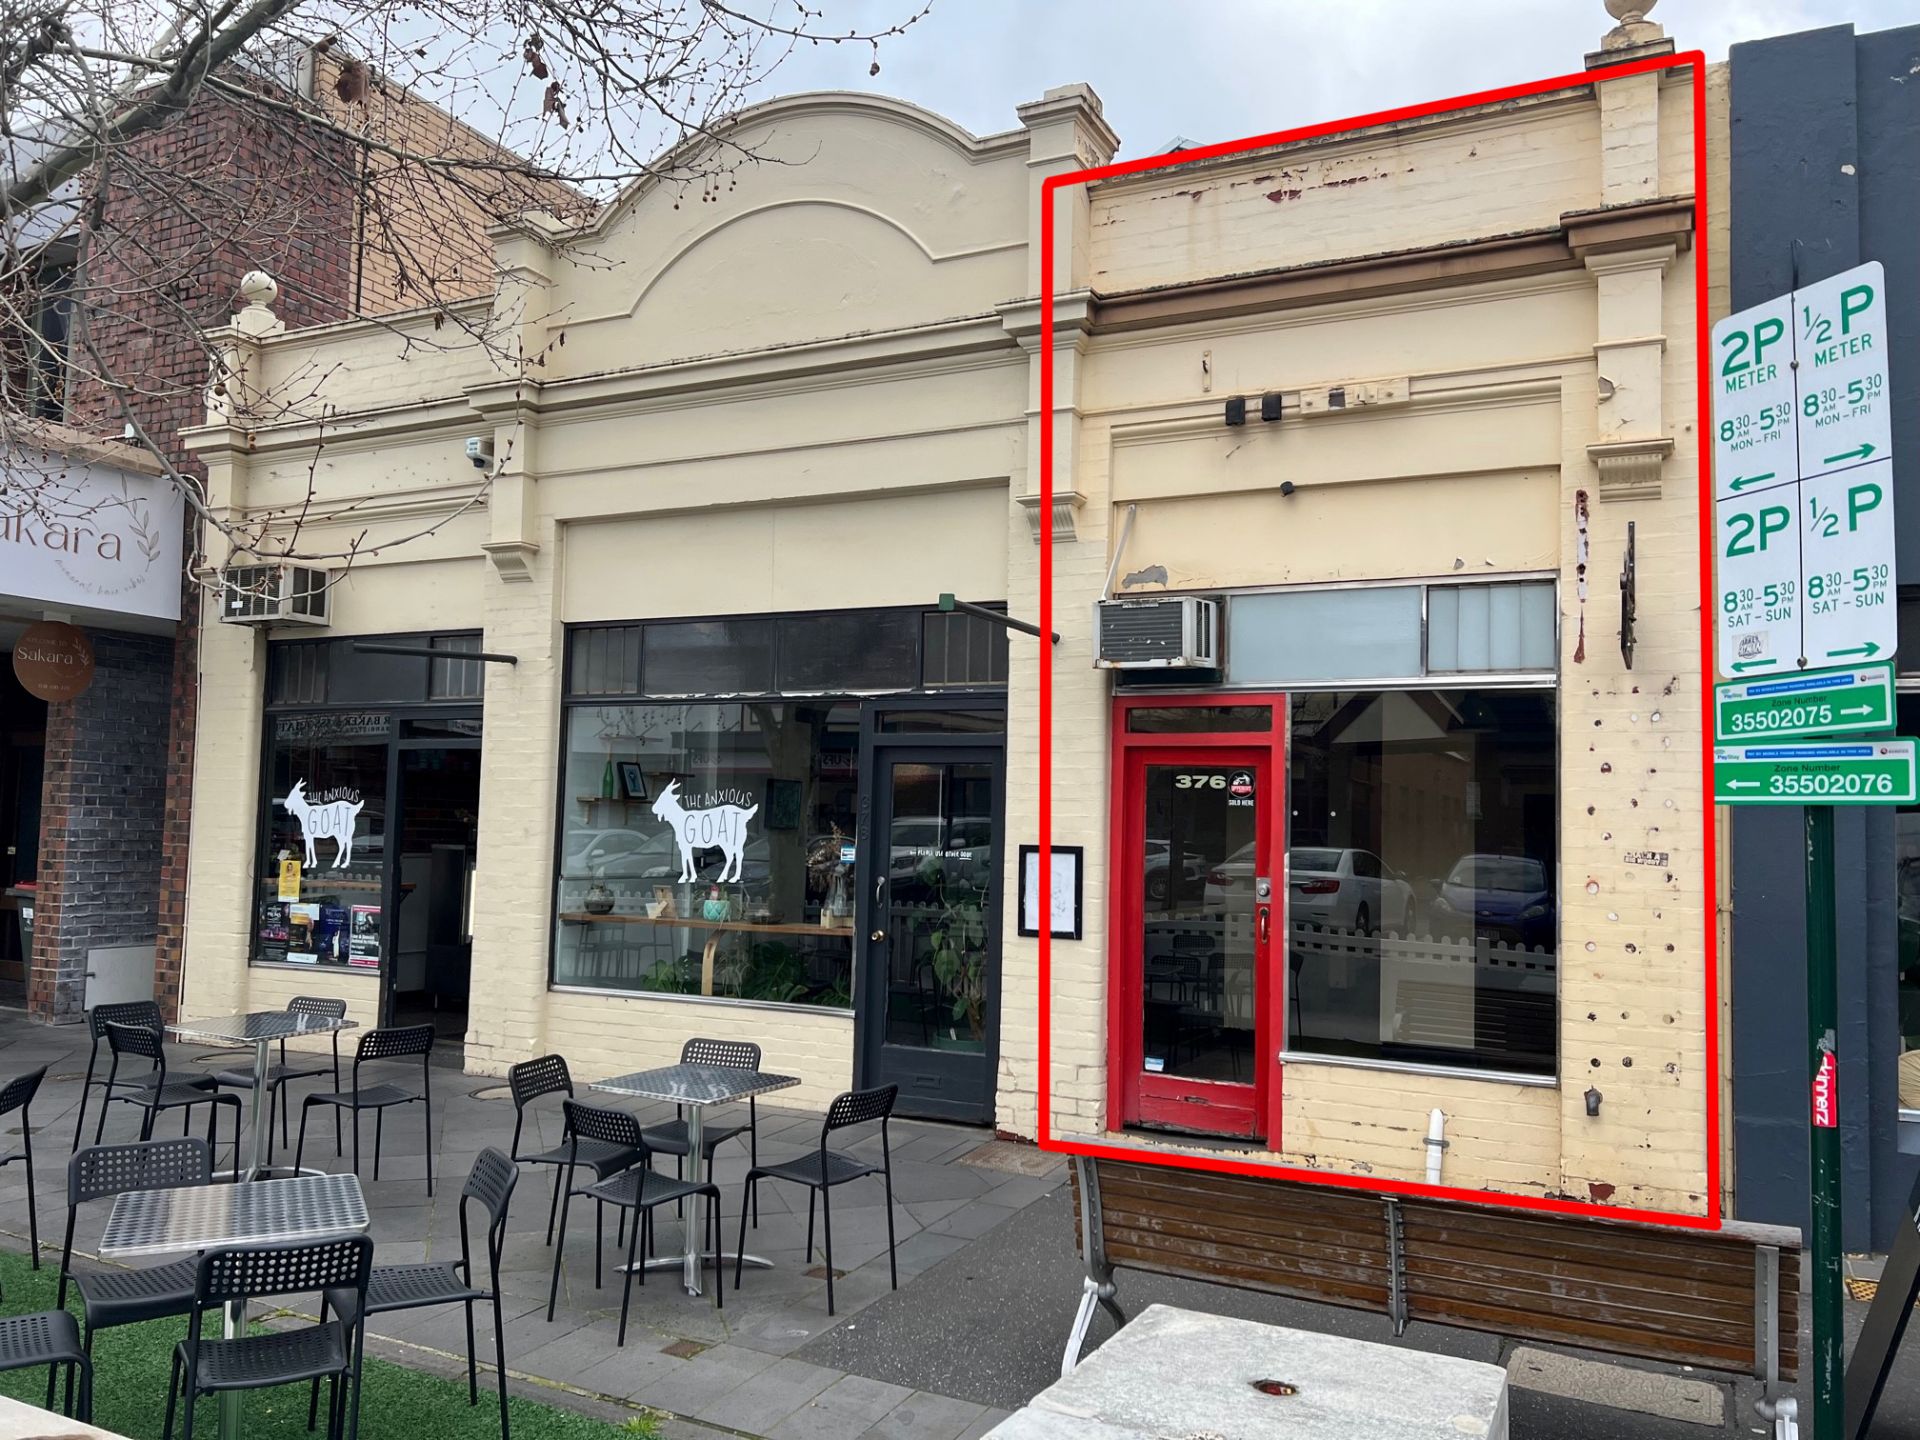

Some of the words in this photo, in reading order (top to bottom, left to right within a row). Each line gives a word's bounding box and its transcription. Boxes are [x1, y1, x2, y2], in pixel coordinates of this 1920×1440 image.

[1721, 318, 1784, 377] 2P
[1814, 334, 1872, 368] METER
[1725, 364, 1777, 394] METER
[1815, 413, 1840, 428] MON
[1852, 403, 1871, 417] FRI
[1730, 438, 1753, 452] MON
[1764, 429, 1781, 442] FRI
[1726, 505, 1790, 558] 2P
[1812, 599, 1840, 614] SAT
[1855, 592, 1885, 607] SUN
[1727, 614, 1752, 628] SAT
[1766, 606, 1792, 622] SUN
[17, 646, 73, 664] Sakara
[1772, 699, 1792, 707] Zone
[1794, 695, 1827, 705] Number
[1731, 704, 1832, 732] 35502075
[1802, 764, 1840, 772] Number
[1175, 775, 1227, 789] 376
[1769, 774, 1892, 794] 35502076
[324, 787, 360, 802] ANXIOUS
[685, 795, 701, 809] THE
[704, 788, 752, 807] ANXIOUS
[308, 804, 351, 836] GOAT
[684, 809, 741, 846] GOAT
